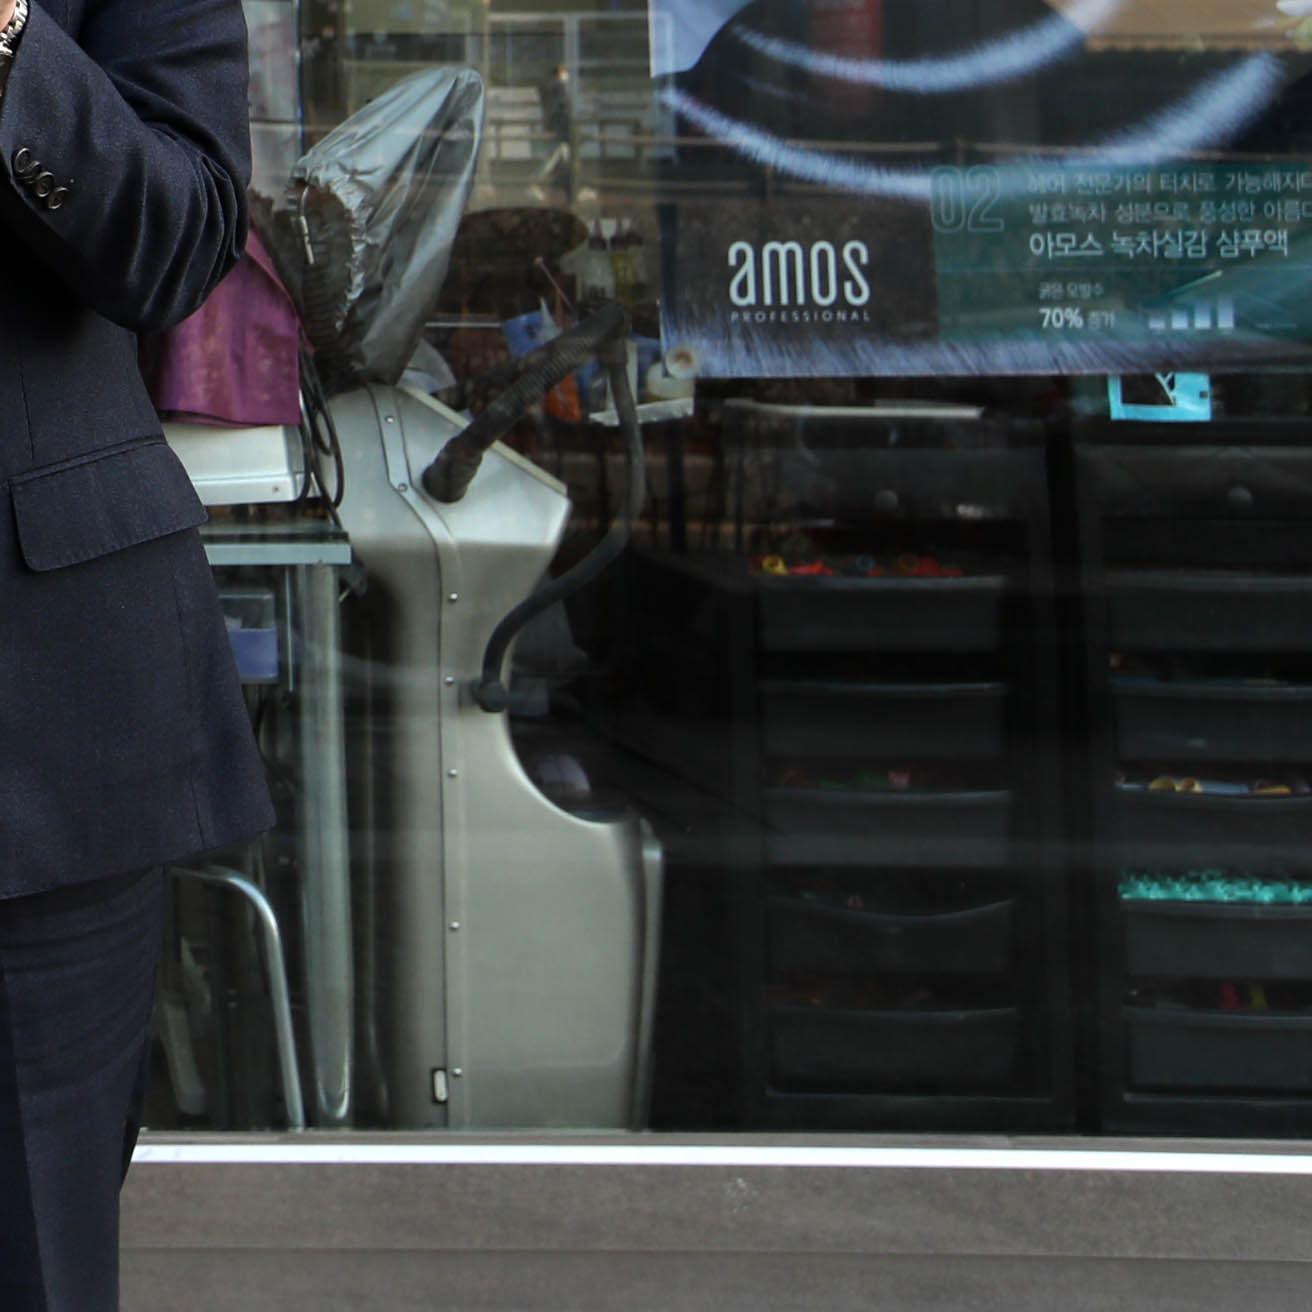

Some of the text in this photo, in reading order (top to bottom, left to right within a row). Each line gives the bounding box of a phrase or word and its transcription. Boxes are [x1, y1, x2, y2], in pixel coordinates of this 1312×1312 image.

[1074, 172, 1152, 194] 전문가의
[1159, 172, 1217, 193] 터치로
[930, 165, 1005, 233] 02
[1114, 201, 1191, 224] 성분으로
[1028, 228, 1289, 260] 아모스 녹차실감 샴푸액
[728, 240, 871, 308] amos
[730, 310, 871, 323] PROFESSIONAL
[1038, 307, 1084, 330] 70%
